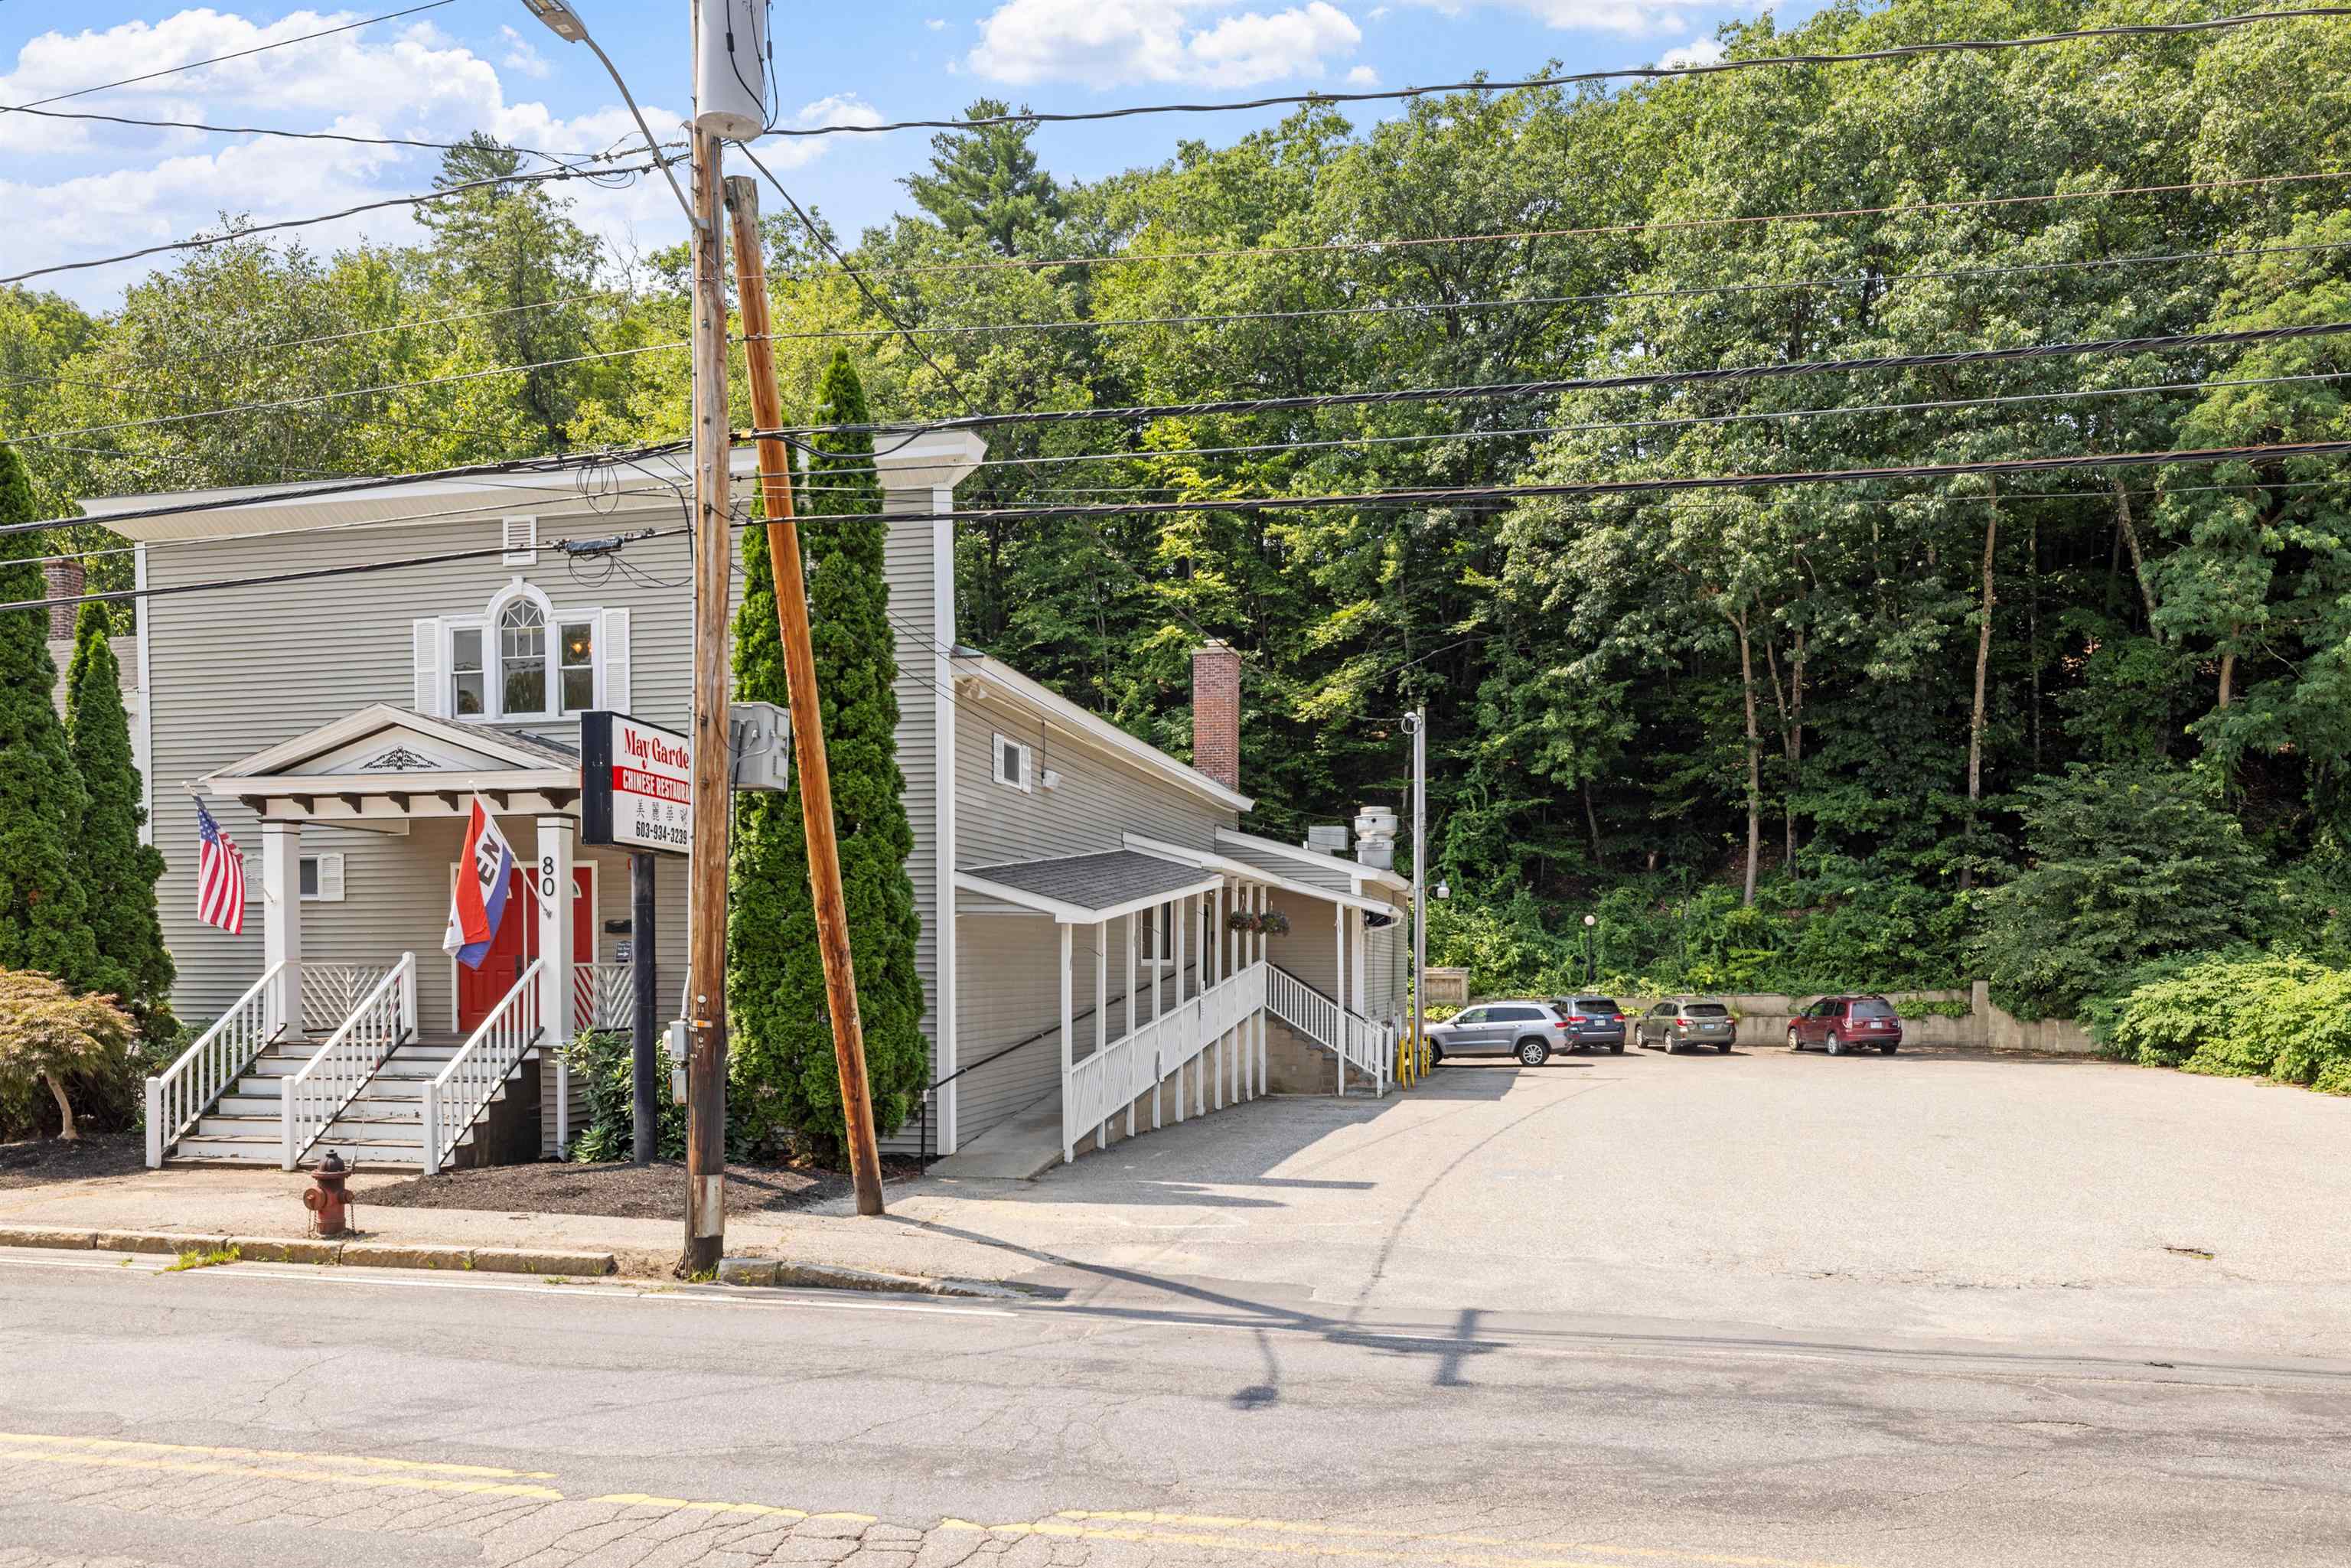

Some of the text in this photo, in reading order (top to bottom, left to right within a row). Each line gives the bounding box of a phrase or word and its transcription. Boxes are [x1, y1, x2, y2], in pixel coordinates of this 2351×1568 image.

[624, 728, 690, 770] May Garde
[623, 769, 690, 803] CHINESE RESTAURA
[636, 820, 688, 845] 603-934-3239
[475, 832, 501, 887] EN
[542, 856, 555, 897] 80
